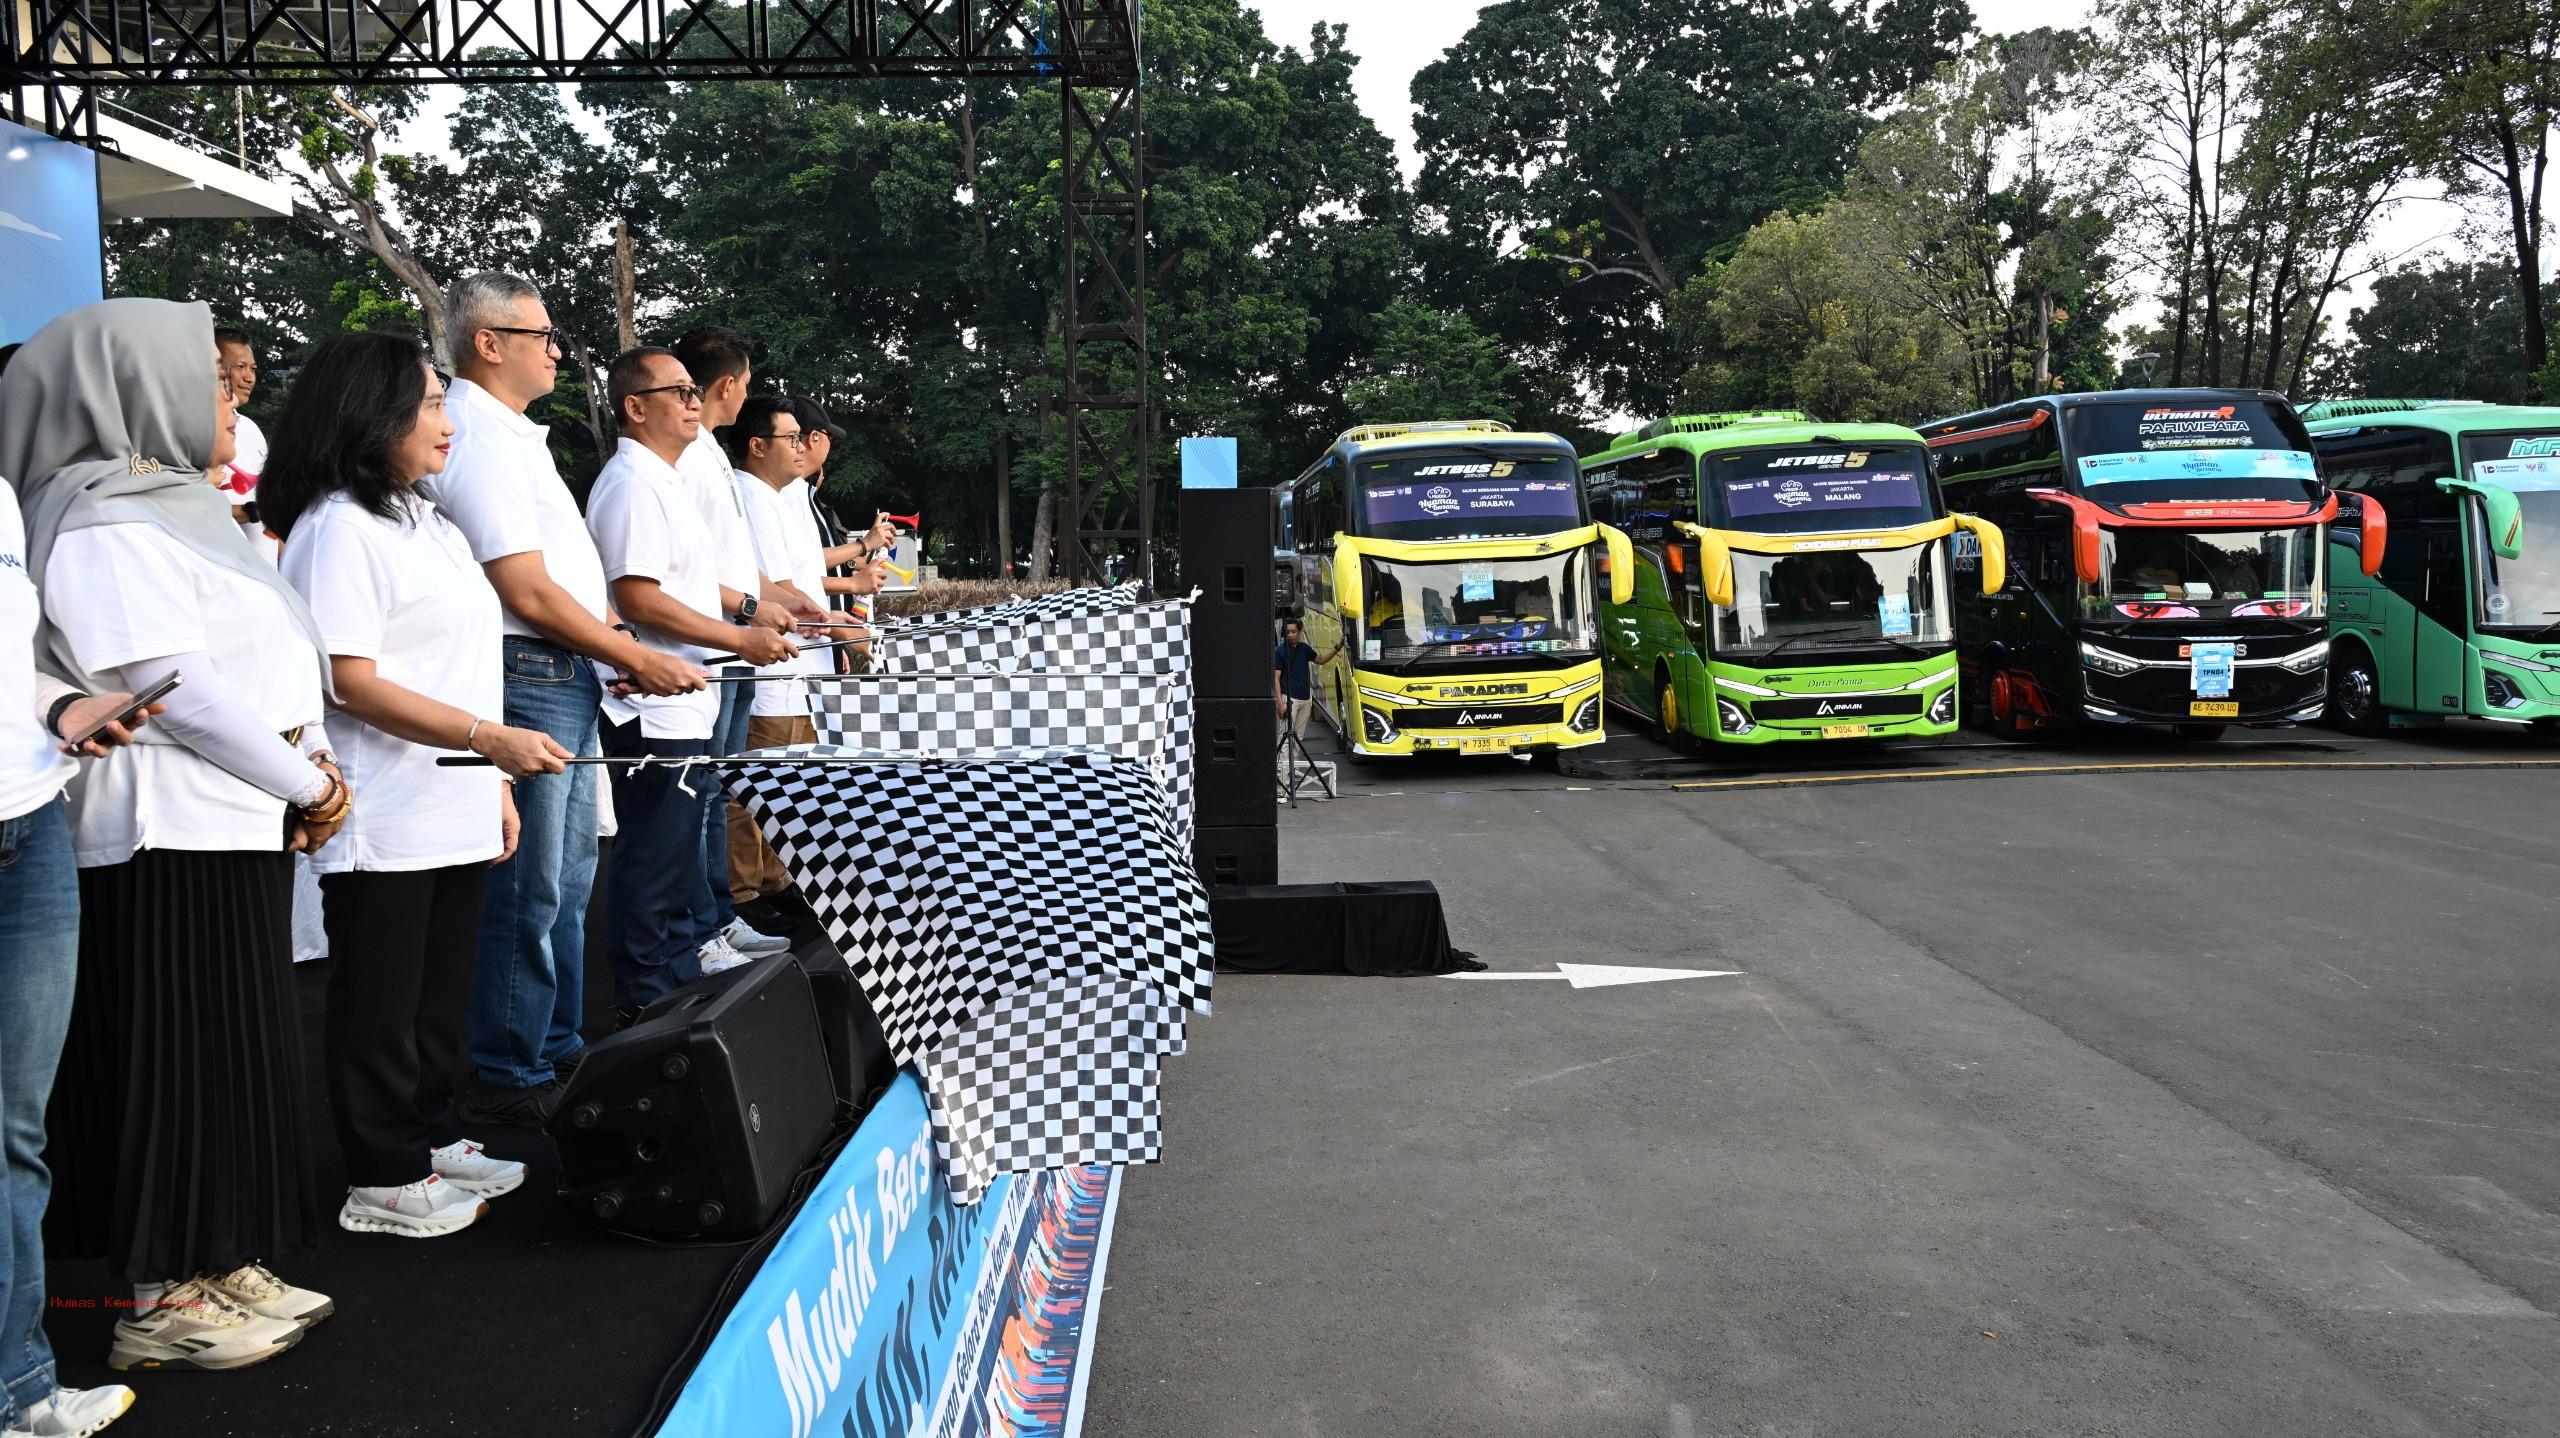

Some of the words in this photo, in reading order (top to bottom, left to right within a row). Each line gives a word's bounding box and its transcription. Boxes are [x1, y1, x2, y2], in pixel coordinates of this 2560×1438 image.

[2140, 420, 2250, 434] PARIWISATA
[1768, 455, 1846, 468] JETBUS
[1414, 463, 1492, 476] JETBUS
[1418, 498, 1459, 509] Nyaman
[1825, 493, 1861, 501] MALANG
[1470, 500, 1515, 508] SURABAYA
[1440, 683, 1528, 697] PARADISE
[767, 1184, 878, 1438] Mudik
[876, 1120, 932, 1265] Bers
[956, 1315, 981, 1394] Gelora
[978, 1270, 997, 1329] Bung
